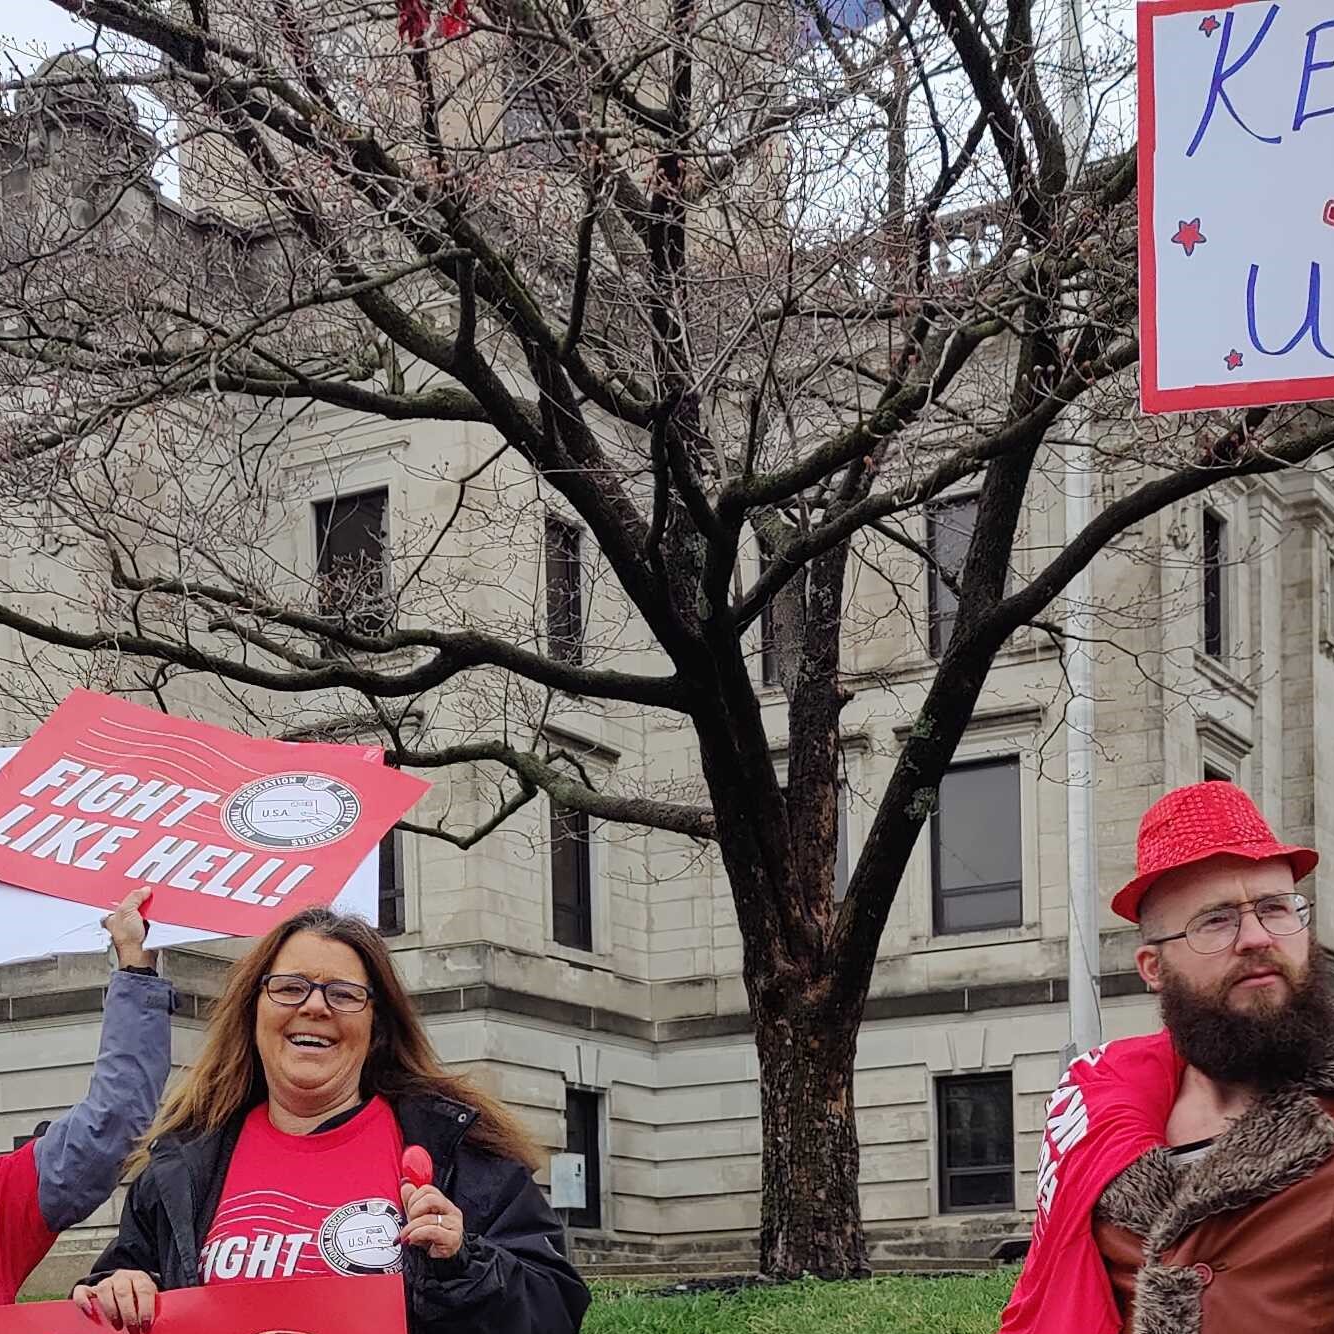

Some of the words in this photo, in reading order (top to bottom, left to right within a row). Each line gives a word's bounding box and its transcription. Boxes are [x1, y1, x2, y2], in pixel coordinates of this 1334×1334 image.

[21, 758, 220, 827] FIGHT
[235, 777, 297, 806] ASSOCIATION
[126, 835, 314, 907] HELL!
